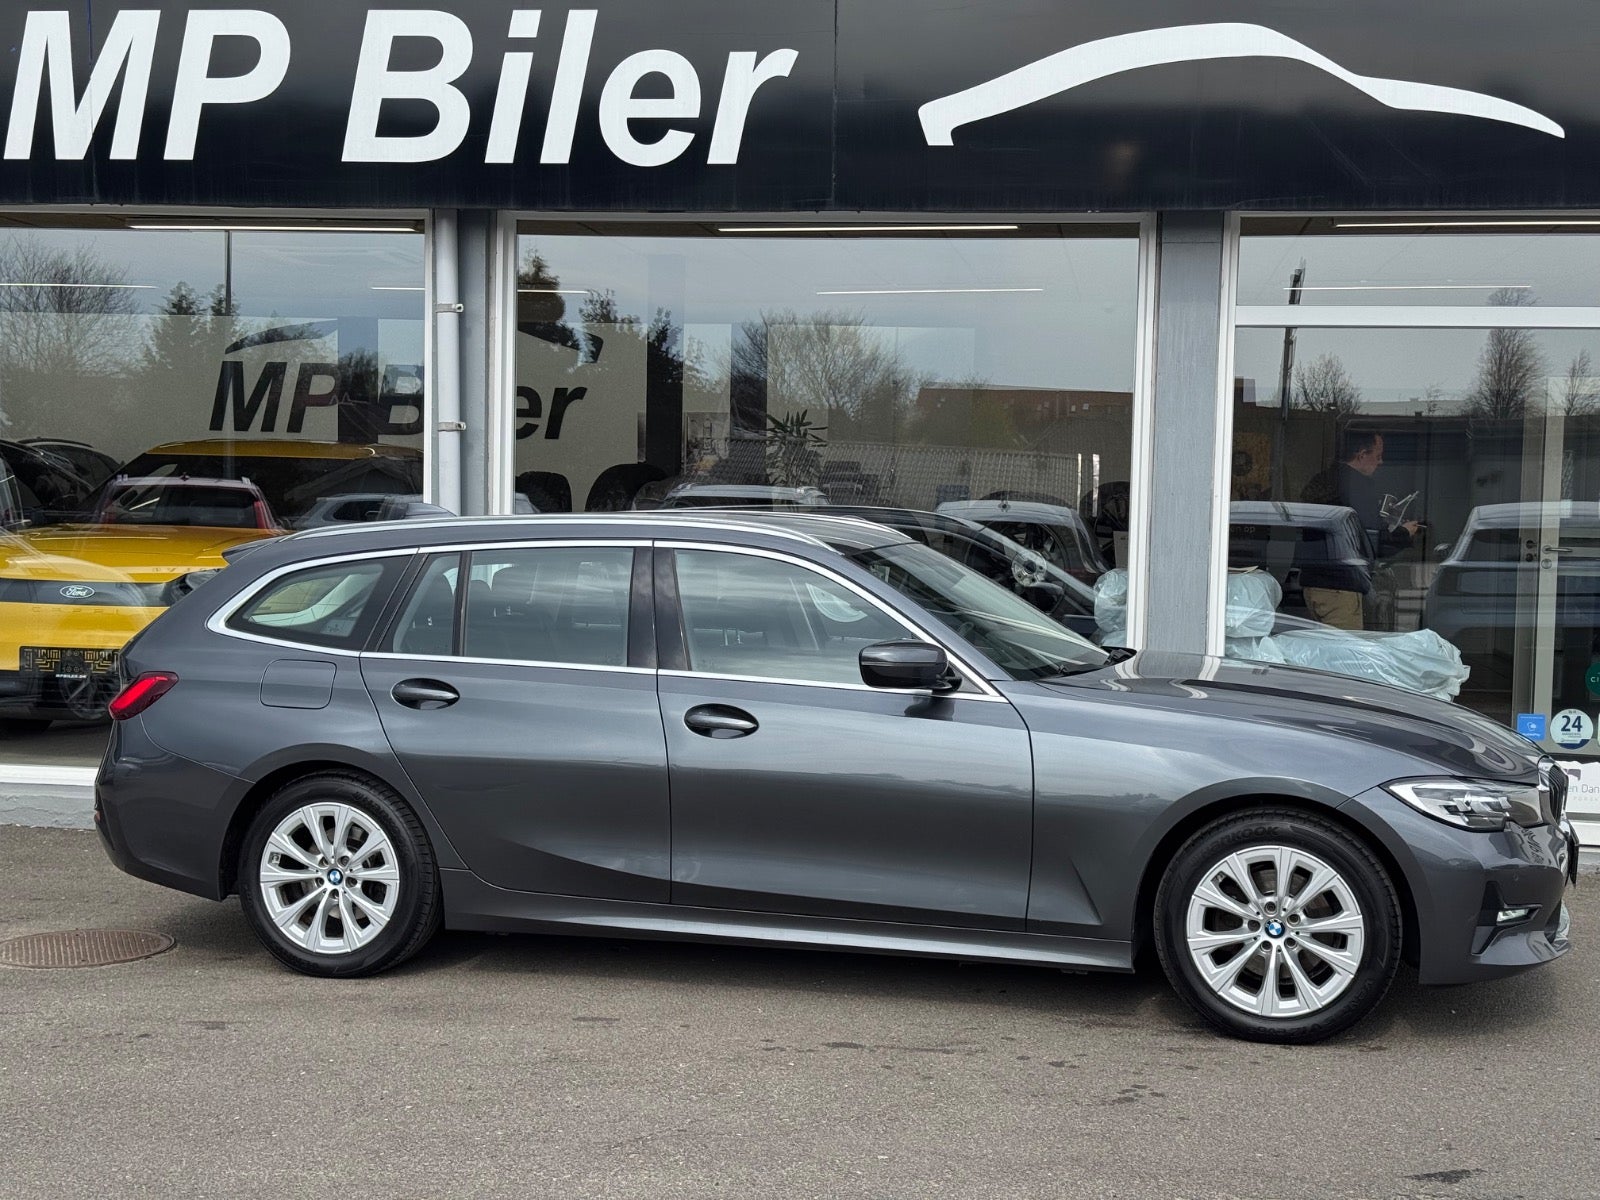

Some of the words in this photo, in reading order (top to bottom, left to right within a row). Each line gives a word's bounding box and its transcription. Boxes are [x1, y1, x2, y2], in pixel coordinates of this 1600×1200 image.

[3, 9, 291, 161] MP
[341, 8, 799, 168] Biler
[208, 360, 342, 433] MP
[64, 585, 90, 598] Ford
[1560, 715, 1583, 732] 24
